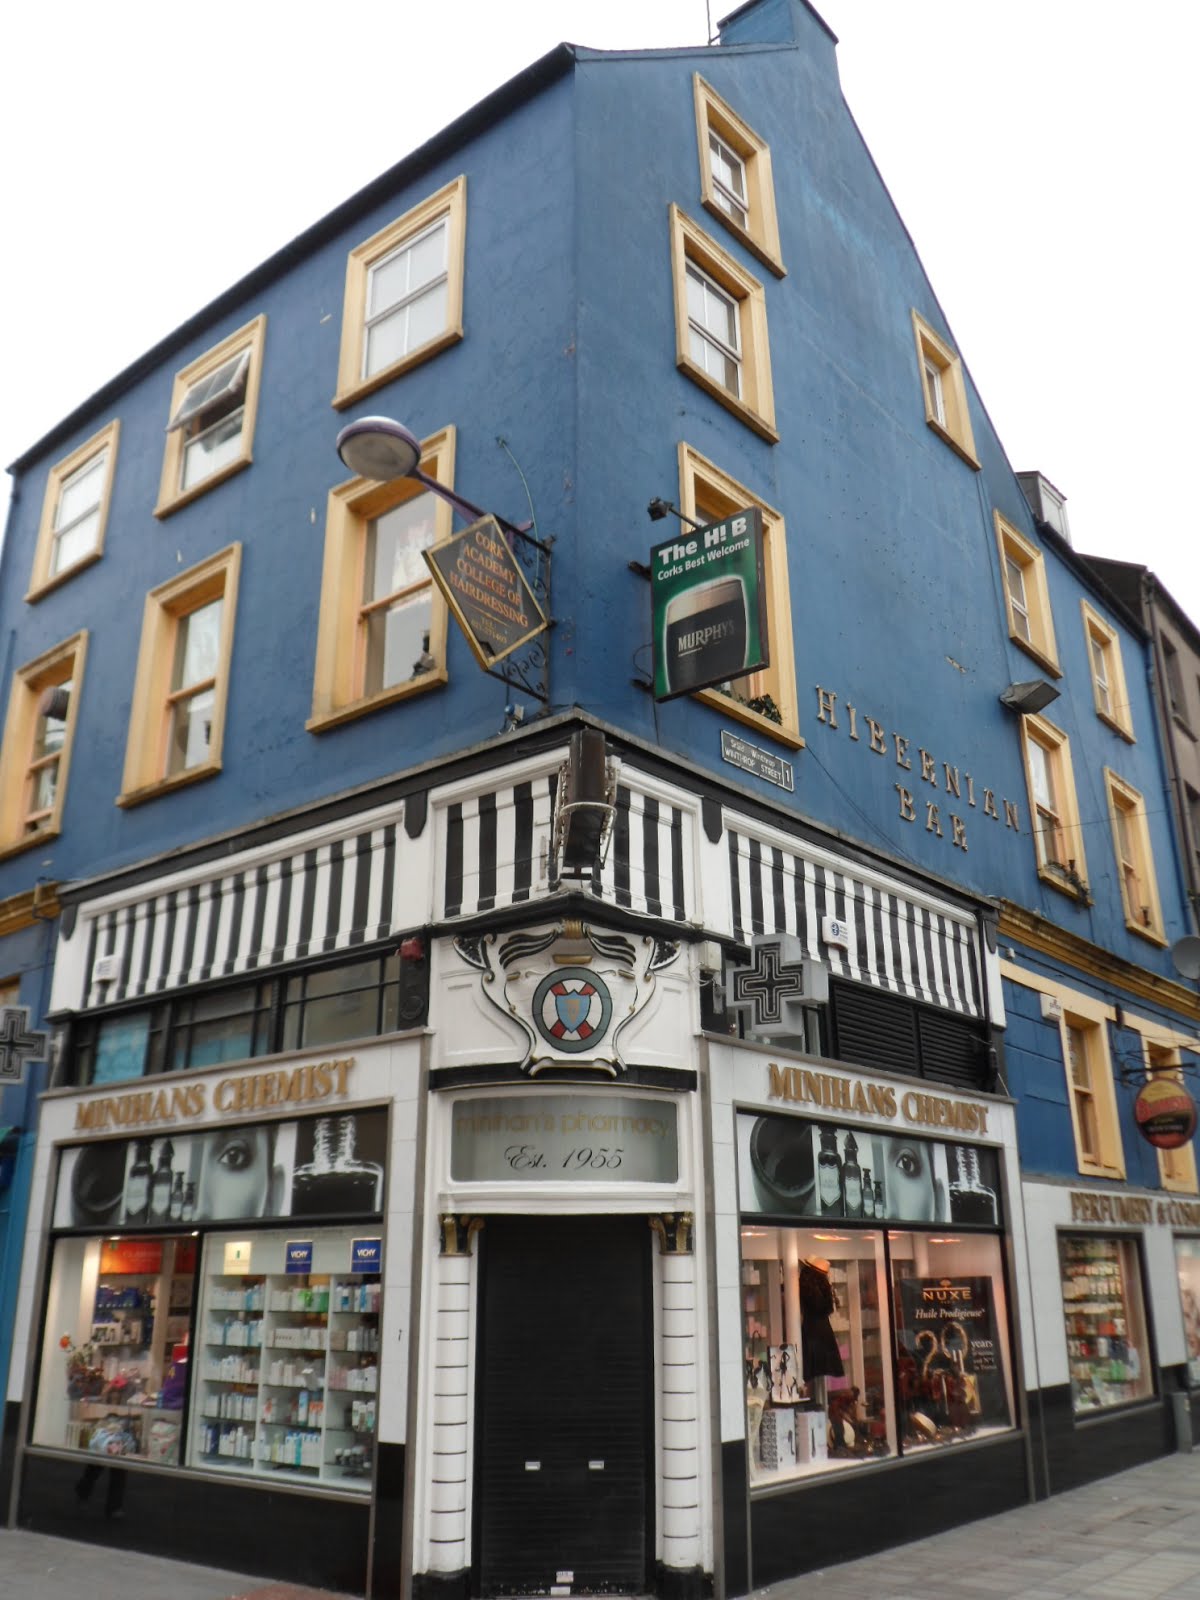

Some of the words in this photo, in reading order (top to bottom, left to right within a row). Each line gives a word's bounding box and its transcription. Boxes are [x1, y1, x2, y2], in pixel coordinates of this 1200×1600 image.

[475, 531, 504, 560] CORK
[657, 565, 683, 581] Corks
[685, 555, 705, 571] Best
[707, 538, 750, 562] Welcome
[658, 541, 698, 565] The
[732, 517, 747, 537] B
[456, 558, 506, 599] COLLEGE
[507, 589, 522, 606] OF
[464, 544, 516, 585] ACADEMY
[449, 571, 528, 628] HAIRDRESSING
[724, 746, 756, 768] WINTHROP
[760, 764, 782, 781] STREET
[815, 685, 1019, 832] HIBERNIAN
[895, 782, 968, 852] BAR
[73, 1082, 206, 1130] MINIHANS
[212, 1057, 355, 1113] CHEMIST
[768, 1063, 898, 1119] MINIHANS
[902, 1090, 989, 1134] CHEMIST
[504, 1145, 547, 1171] Est.
[562, 1147, 625, 1171] 1955
[290, 1250, 309, 1259] VICHY
[356, 1248, 377, 1257] VICHY
[915, 1308, 938, 1319] Huile
[923, 1290, 972, 1301] NUXE
[970, 1340, 993, 1351] years
